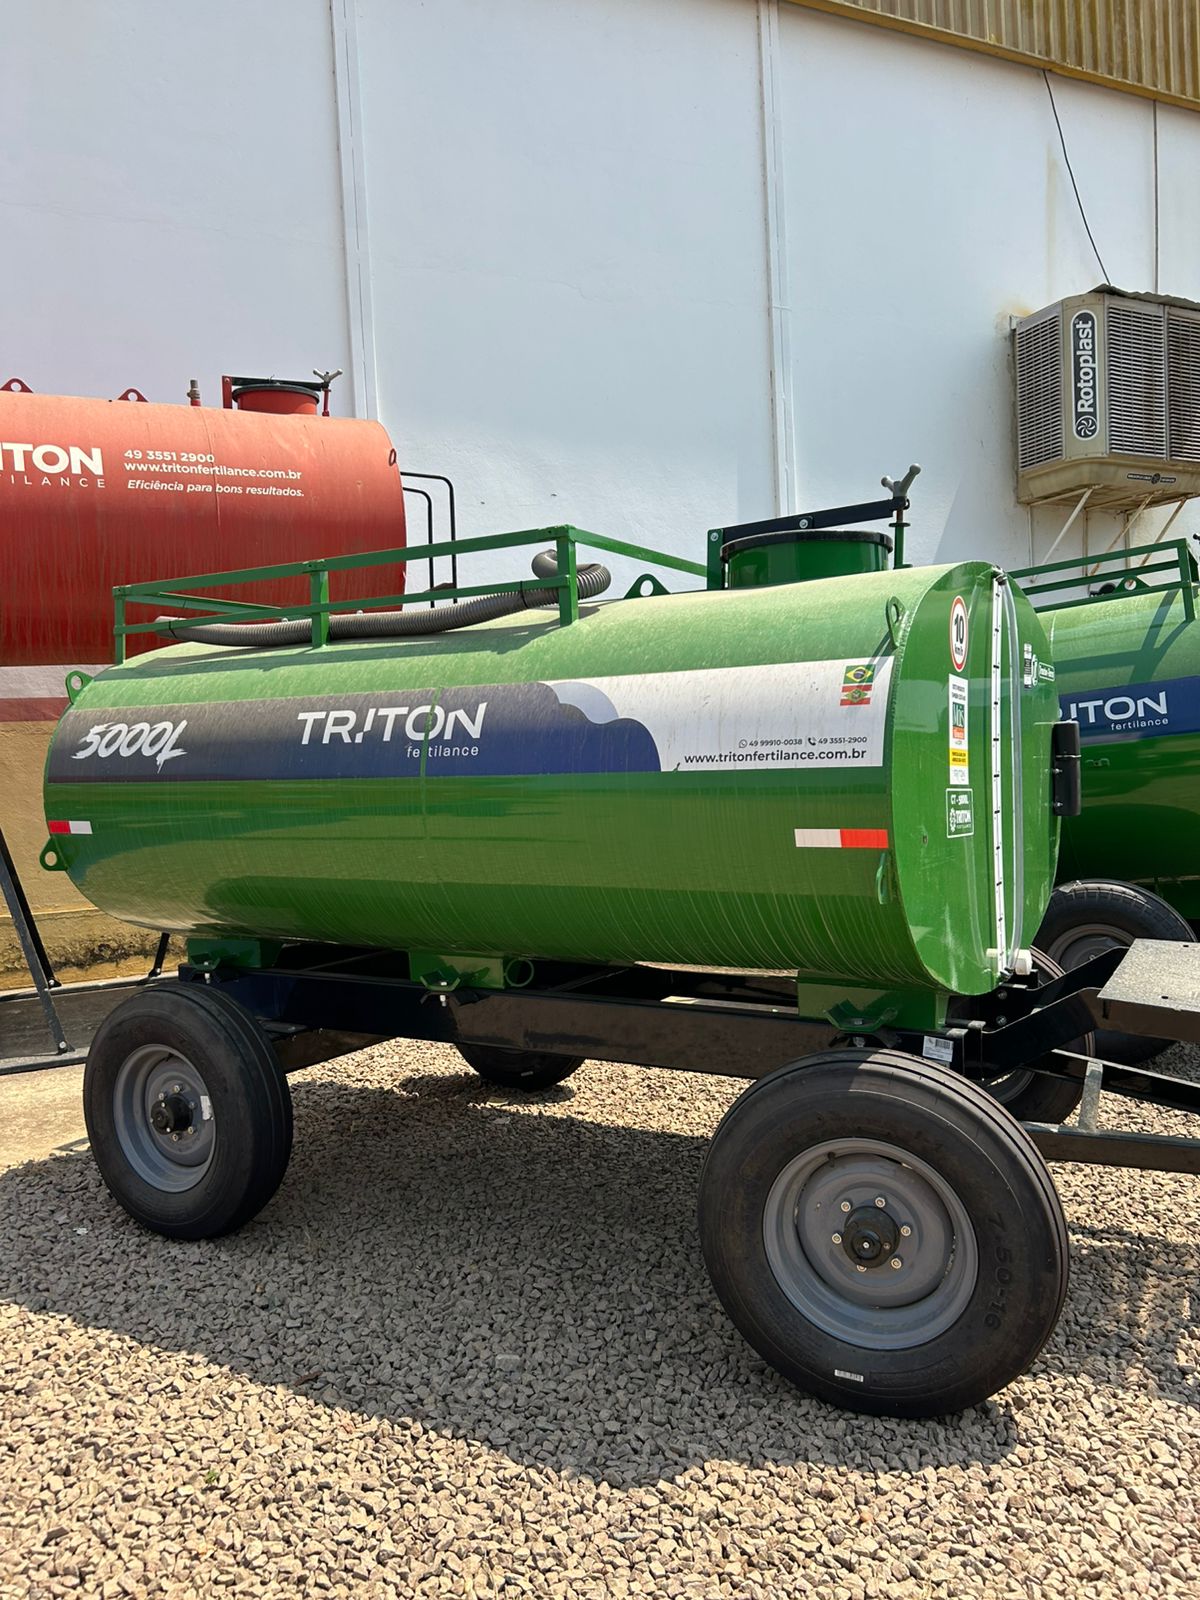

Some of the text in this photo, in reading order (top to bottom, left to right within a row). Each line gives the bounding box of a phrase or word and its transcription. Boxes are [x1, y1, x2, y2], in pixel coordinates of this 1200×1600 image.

[1076, 320, 1095, 413] Rotoplast
[124, 449, 215, 463] 49 3551 2900
[124, 462, 302, 479] www.tritonfertilance.com.br
[0, 473, 105, 488] ILANCE
[127, 479, 305, 497] Eficiência para bons resultados.
[954, 613, 965, 644] 10
[297, 702, 488, 745] TRITON
[1110, 718, 1169, 731] fertilance
[71, 720, 188, 774] 5000L
[829, 736, 868, 744] 3551-2900
[406, 745, 479, 758] fetilance
[684, 748, 867, 764] www.tritonfertilance.com.br
